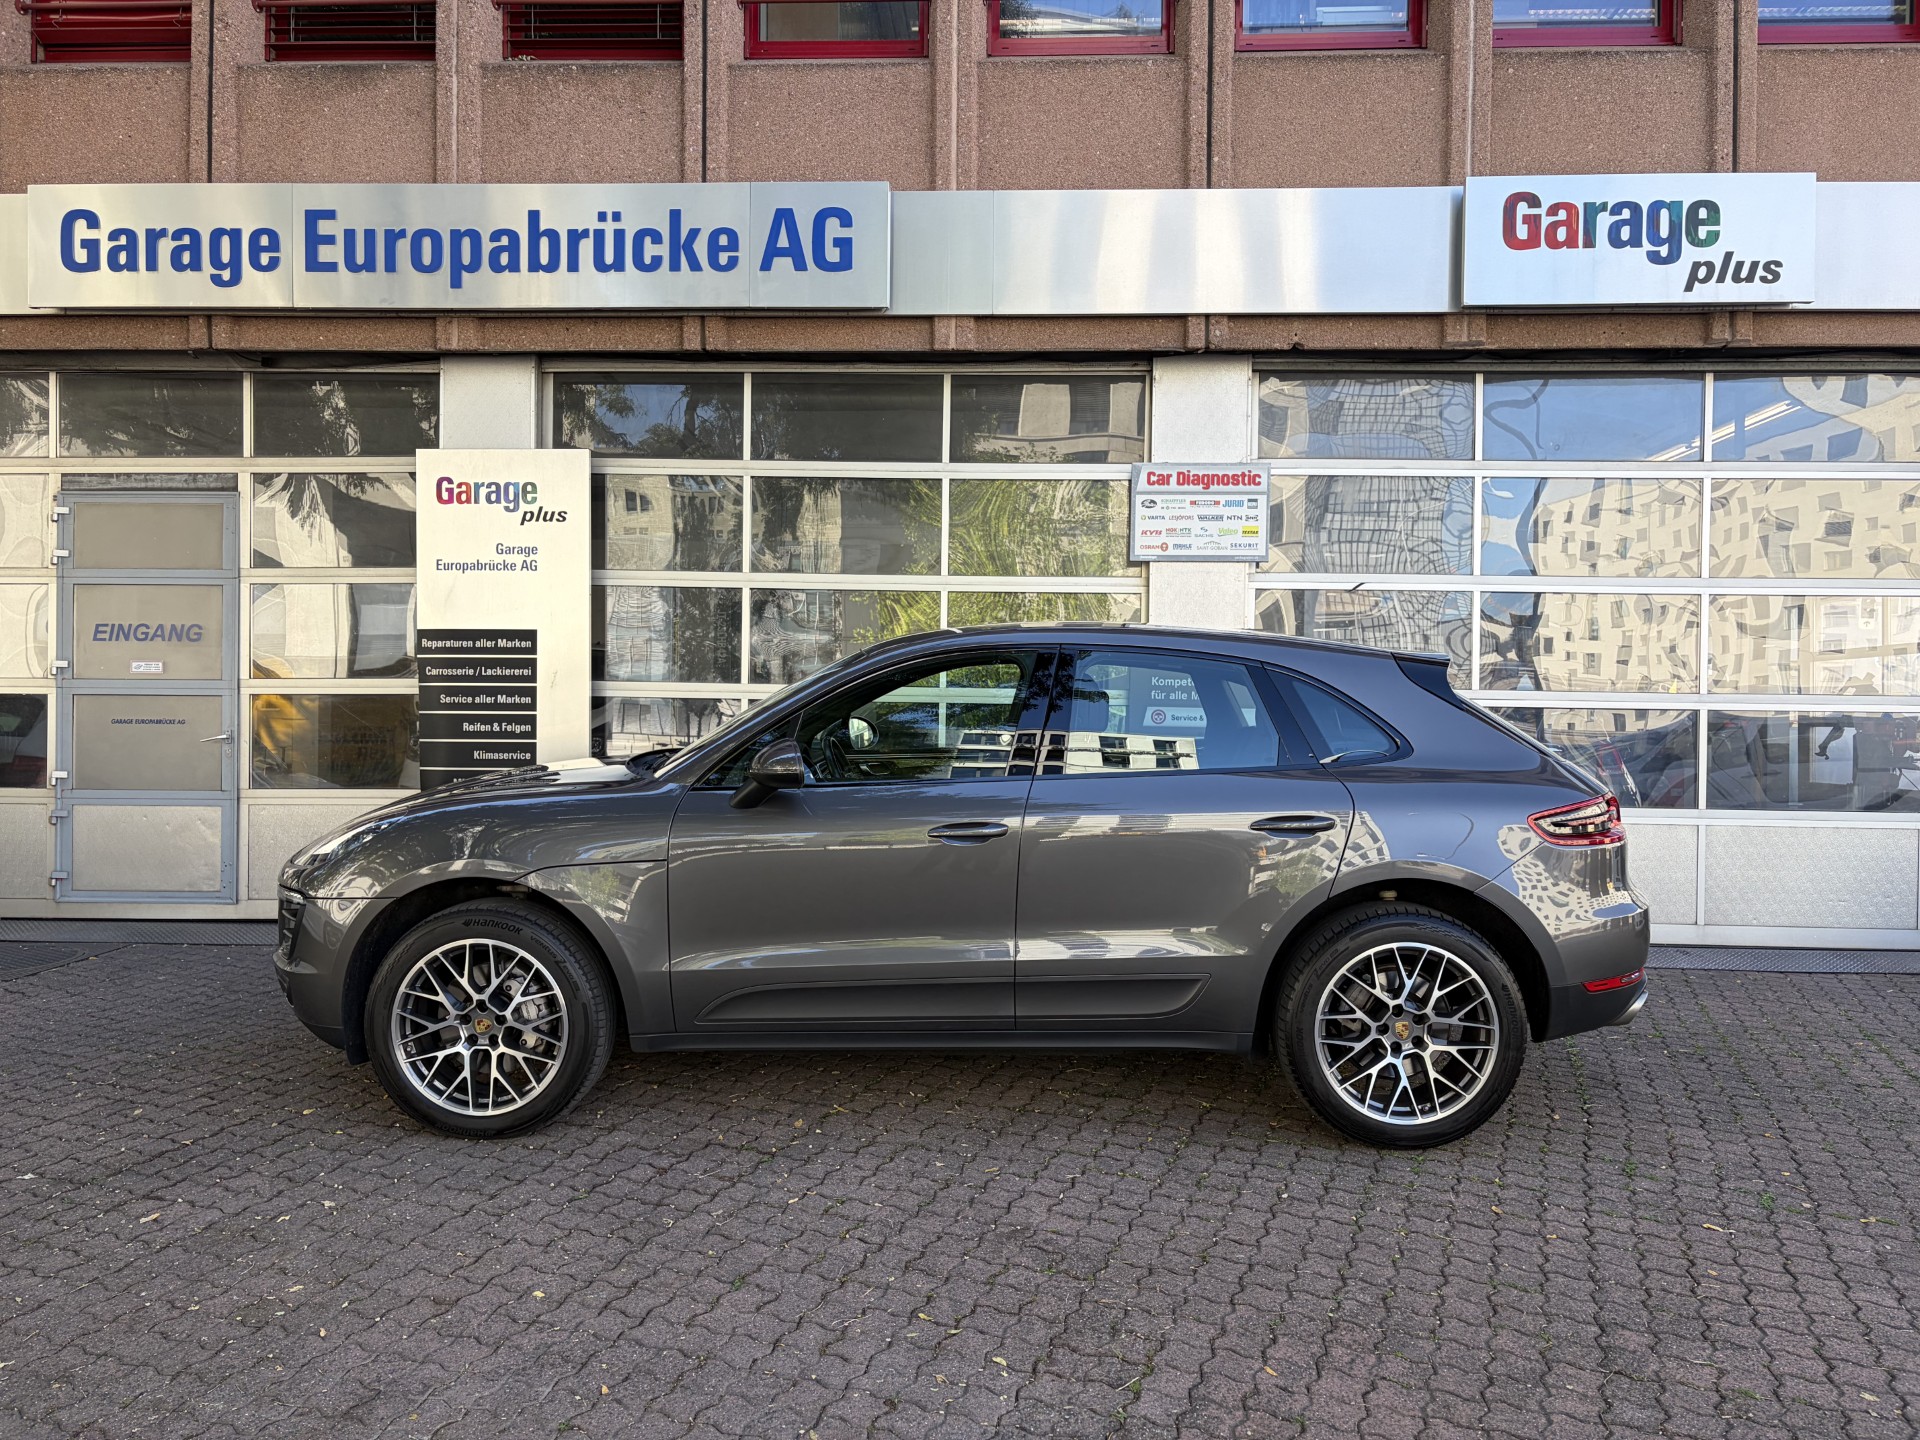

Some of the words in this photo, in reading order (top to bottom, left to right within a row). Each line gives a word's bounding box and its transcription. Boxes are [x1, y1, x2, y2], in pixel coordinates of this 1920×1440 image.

[1502, 191, 1721, 265] Garage
[60, 209, 281, 288] Garage
[304, 208, 739, 289] Europabrücke
[759, 207, 854, 272] AG
[1683, 251, 1783, 292] plus
[1146, 471, 1173, 486] Car
[1177, 470, 1262, 490] Diagnostic
[436, 476, 538, 513] Garage
[520, 506, 568, 526] plus
[495, 543, 538, 557] Garage
[436, 559, 517, 573] Europabrücke
[520, 560, 538, 572] AG
[92, 623, 203, 642] EINGANG
[421, 638, 473, 650] Reparaturen
[475, 639, 495, 648] aller
[498, 639, 532, 648] Marken
[426, 666, 474, 676] Carrosserie
[476, 666, 480, 676] /
[482, 666, 532, 676] Lackiererei
[440, 694, 472, 704] Service
[475, 695, 495, 704] aller
[498, 695, 532, 704] Marken
[1152, 690, 1166, 700] für
[1170, 691, 1188, 700] alle
[463, 722, 490, 732] Reifen
[492, 723, 500, 732] &
[502, 722, 532, 734] Felgen
[474, 750, 531, 760] Klimaservice
